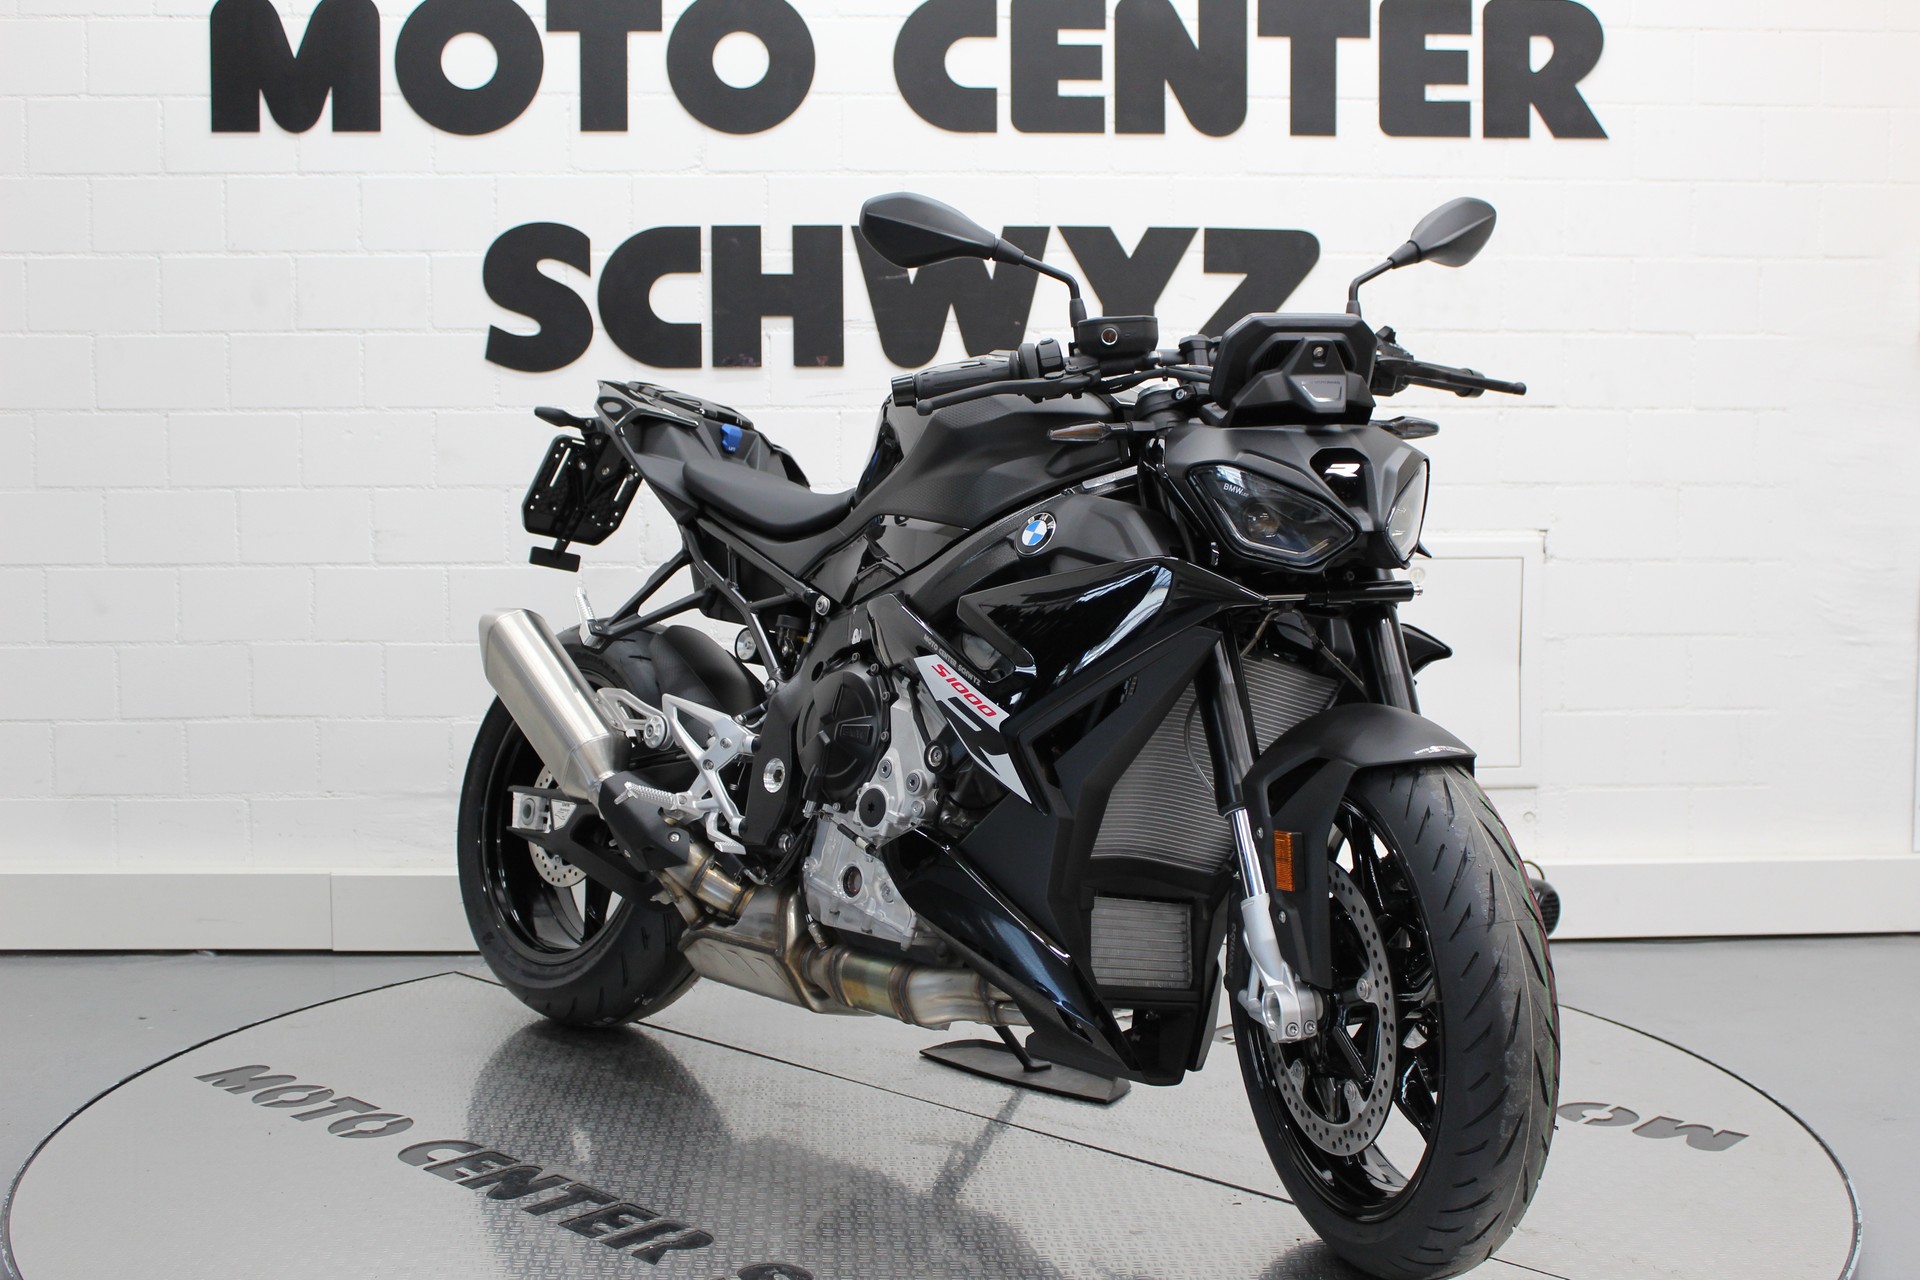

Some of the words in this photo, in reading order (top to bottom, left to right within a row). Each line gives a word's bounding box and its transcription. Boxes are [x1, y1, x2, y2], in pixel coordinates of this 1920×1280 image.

[211, 0, 815, 136] MOTO
[893, 0, 1609, 140] CENTER
[1223, 482, 1244, 495] BMW
[923, 634, 938, 651] MOTO
[938, 648, 957, 668] CENTER
[957, 664, 981, 687] SCHWYZ
[931, 663, 997, 717] S1000
[1556, 1101, 1750, 1152] MO
[193, 1064, 415, 1139] MOTO
[397, 1139, 715, 1266] CENTER
